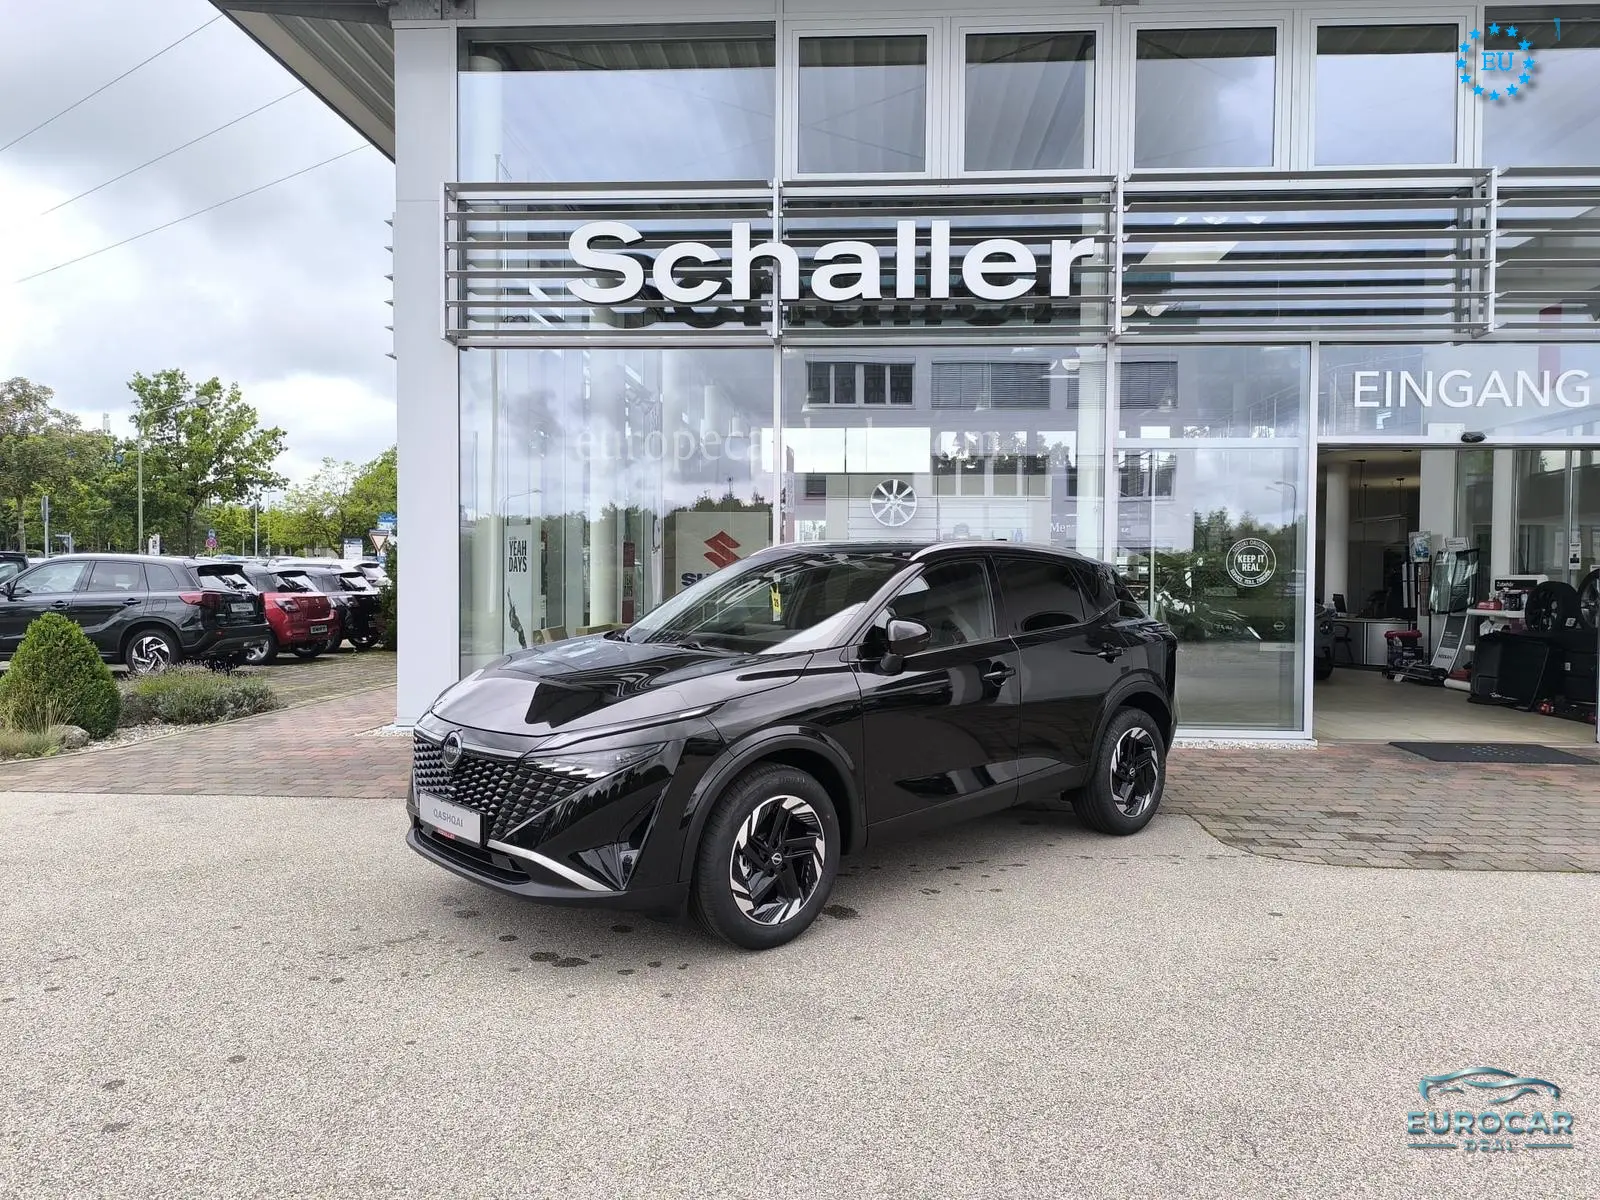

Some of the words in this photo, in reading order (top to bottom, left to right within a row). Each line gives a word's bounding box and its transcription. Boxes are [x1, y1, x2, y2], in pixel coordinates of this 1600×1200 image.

[566, 219, 1095, 304] Schaller
[1353, 369, 1591, 408] EINGANG
[509, 540, 527, 556] YEAH
[508, 556, 527, 573] DAYS
[1237, 554, 1256, 563] KEEP
[1257, 554, 1265, 563] IT
[1241, 563, 1261, 572] REAL
[433, 808, 463, 828] QASHQAI
